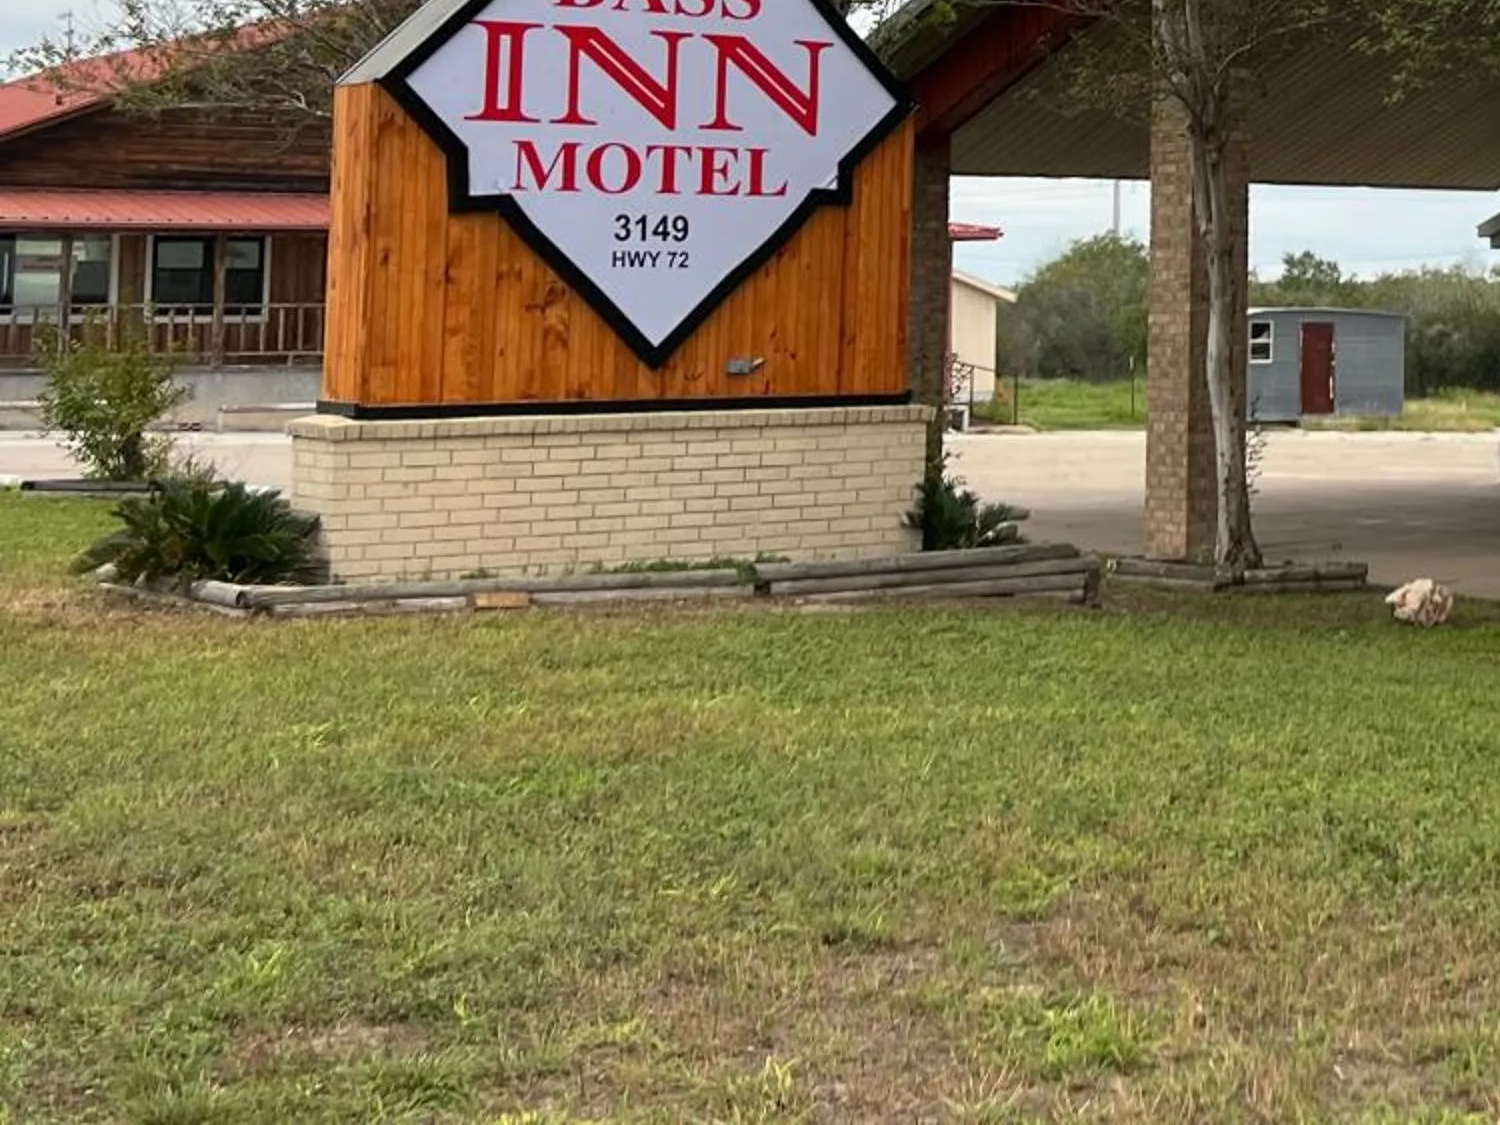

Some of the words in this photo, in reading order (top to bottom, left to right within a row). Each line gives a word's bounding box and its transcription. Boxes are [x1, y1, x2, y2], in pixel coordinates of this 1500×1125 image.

[464, 19, 834, 137] INN
[511, 140, 788, 197] MOTEL
[614, 214, 689, 243] 3149
[611, 250, 661, 268] HWY
[667, 251, 689, 269] 72
